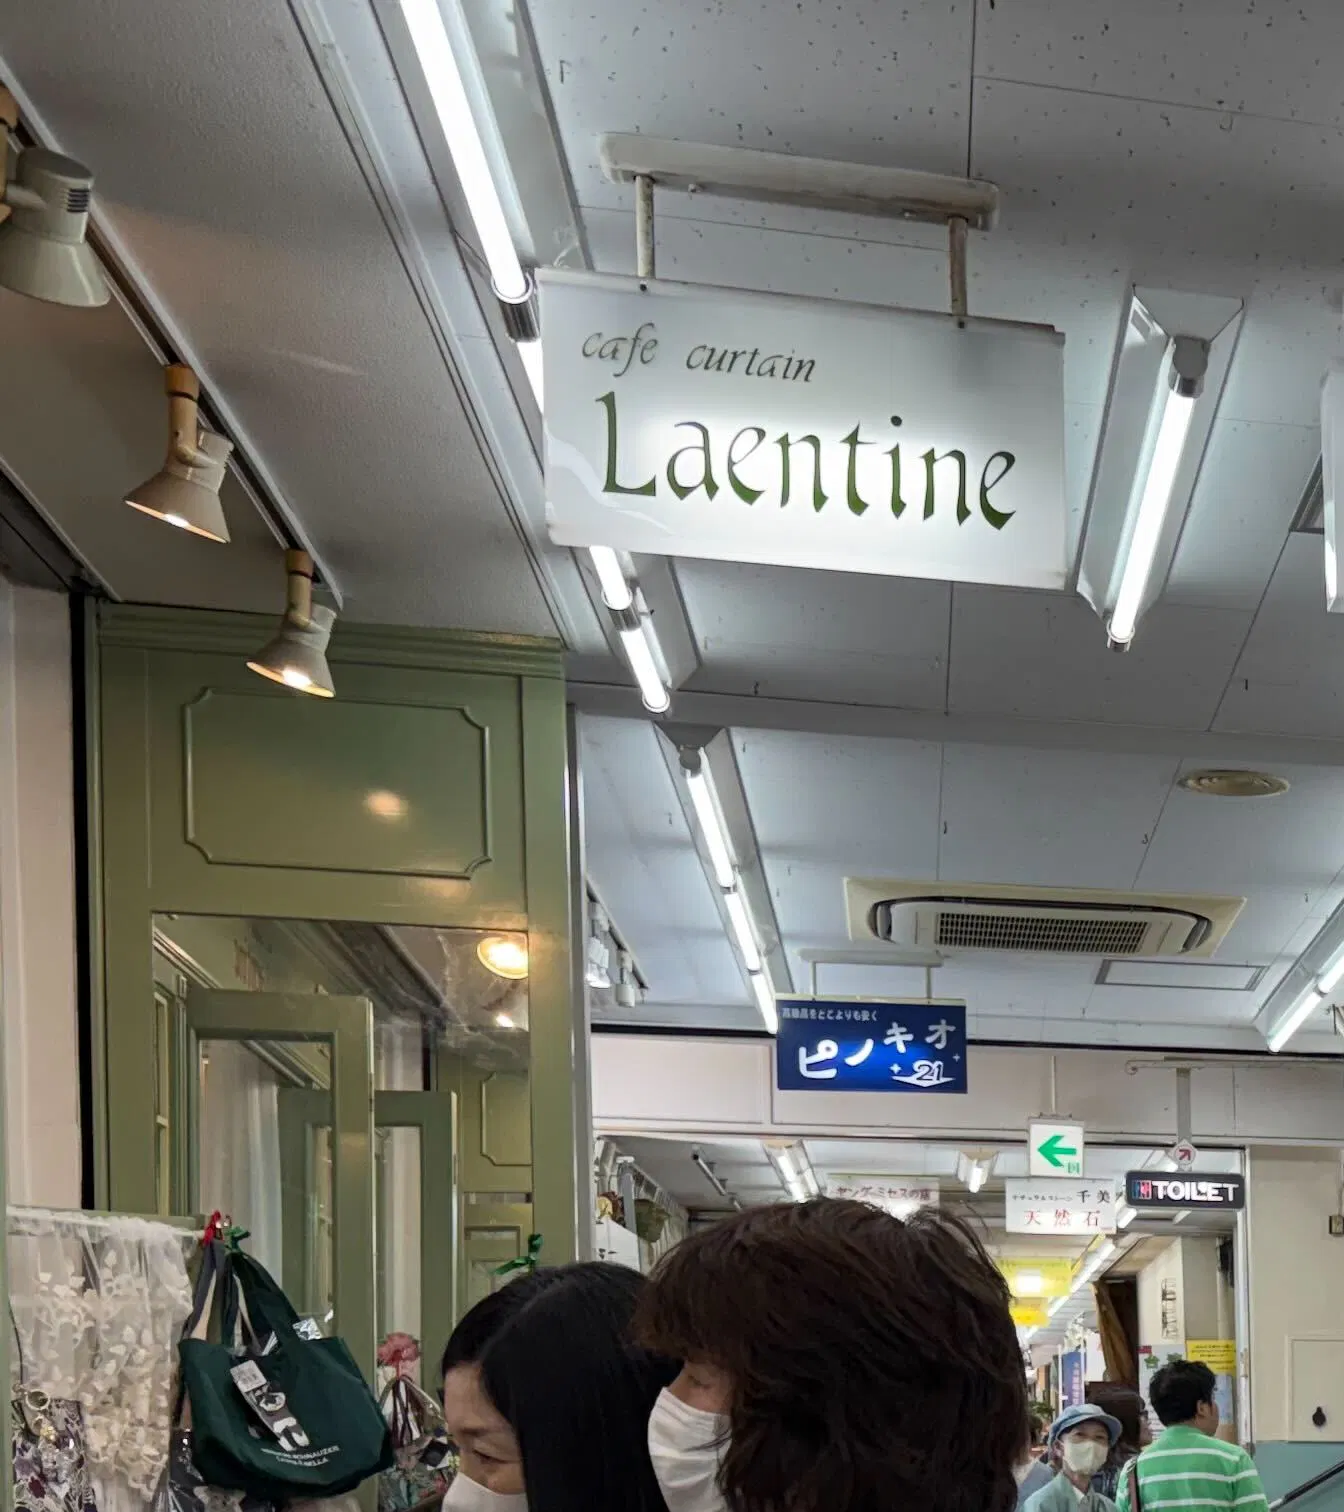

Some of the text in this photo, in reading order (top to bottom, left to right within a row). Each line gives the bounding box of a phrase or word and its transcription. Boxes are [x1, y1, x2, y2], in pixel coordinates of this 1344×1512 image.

[581, 322, 817, 383] cafe curtain
[595, 390, 1017, 530] Laentine
[798, 1019, 956, 1079] ピノキオ
[912, 1060, 944, 1082] 21
[1152, 1180, 1239, 1202] TOILET
[1024, 1209, 1101, 1227] 天然石
